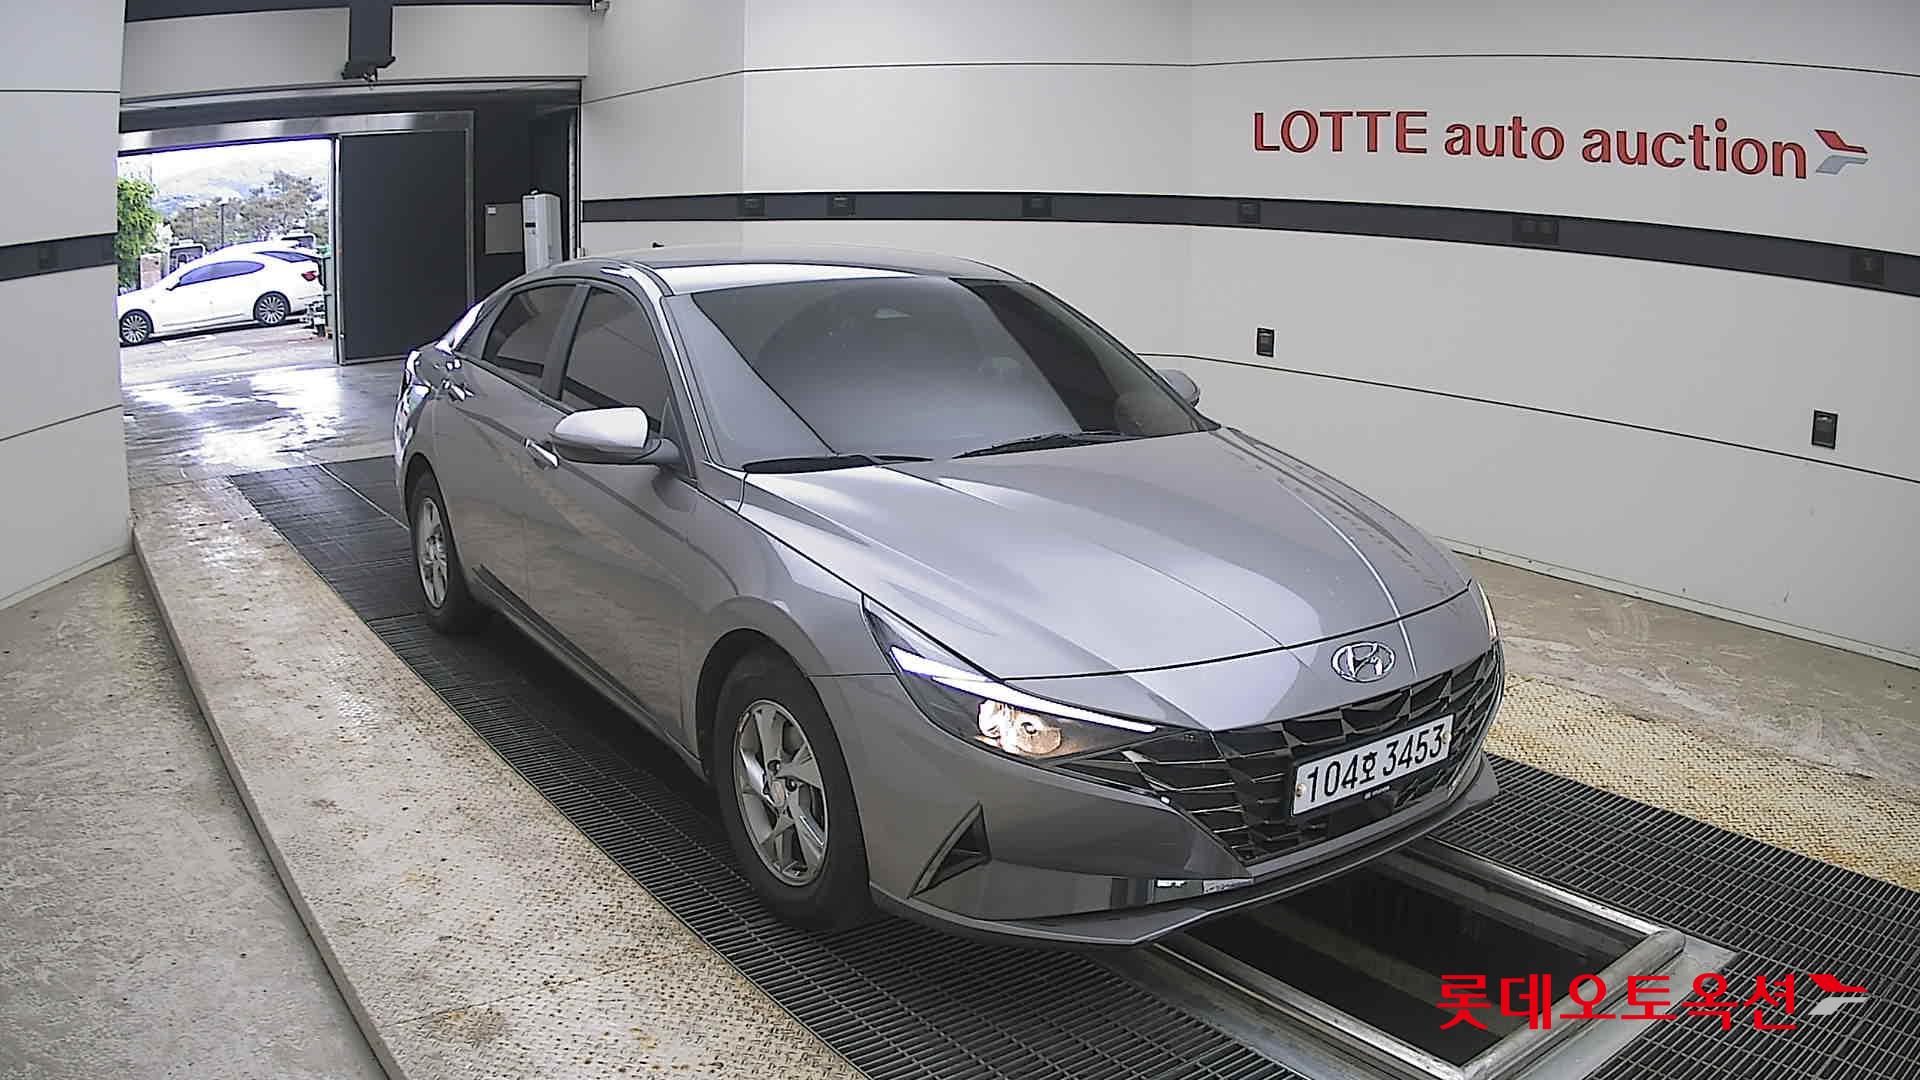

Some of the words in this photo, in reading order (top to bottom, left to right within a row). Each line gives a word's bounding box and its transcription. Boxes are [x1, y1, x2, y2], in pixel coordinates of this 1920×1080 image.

[1253, 111, 1428, 154] LOTTE
[1443, 116, 1565, 160] auto
[1581, 118, 1807, 179] auction
[1307, 751, 1378, 803] 104호
[1383, 723, 1445, 777] 3453
